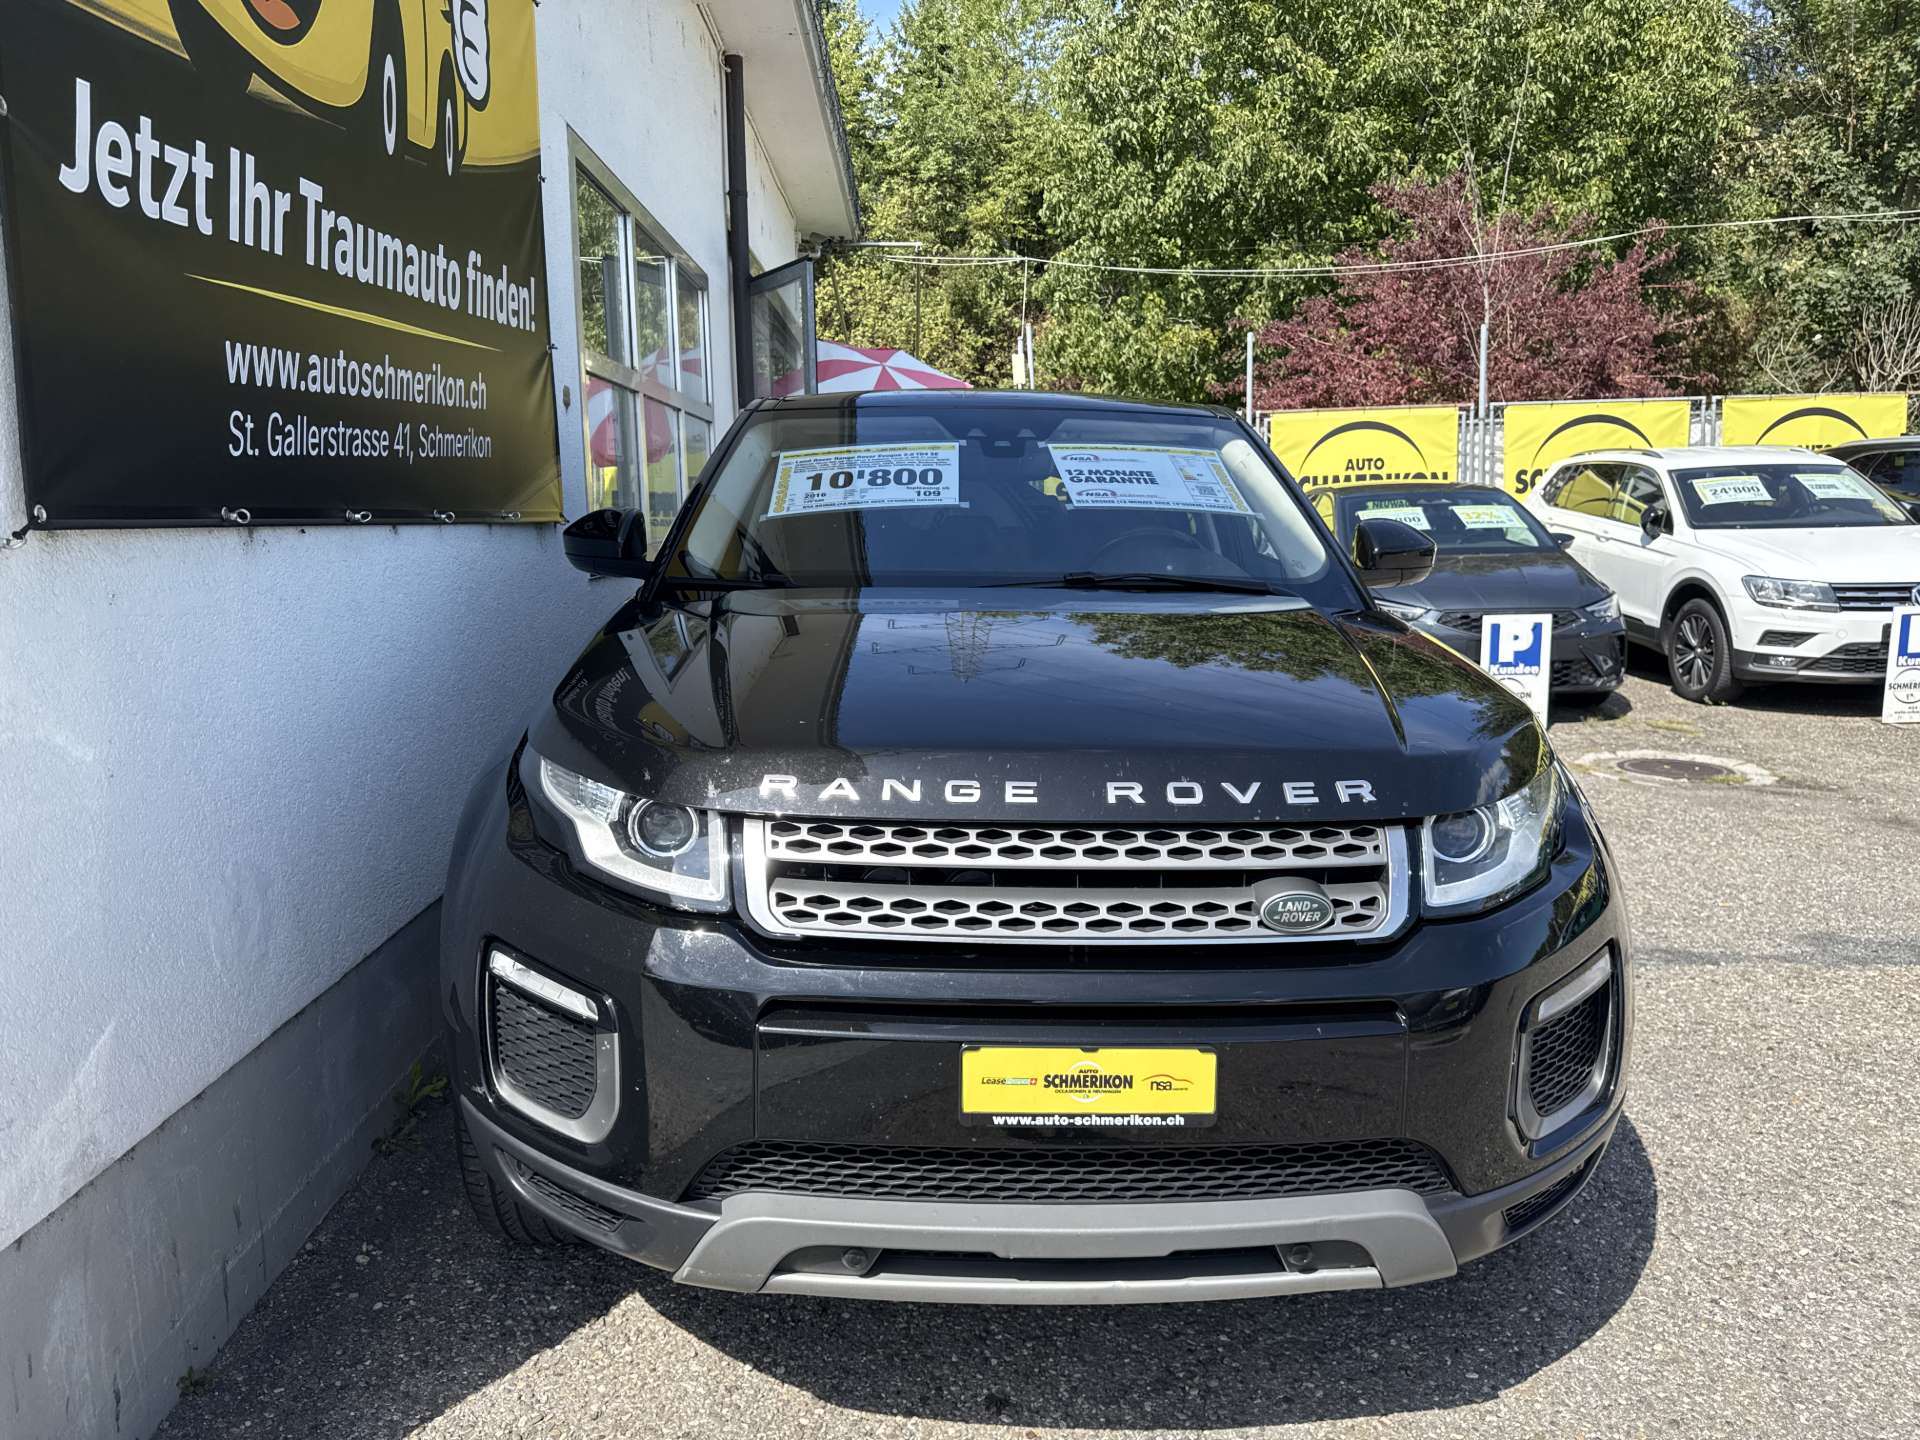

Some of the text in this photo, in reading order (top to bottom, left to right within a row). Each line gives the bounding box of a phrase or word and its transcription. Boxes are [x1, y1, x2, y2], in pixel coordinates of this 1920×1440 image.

[58, 77, 536, 333] Jetzt Ihr Traumauto finden!
[225, 340, 488, 411] www.autoschmerikon.ch
[228, 411, 492, 465] St. Gallerstrasse 41, Schmerikon
[1344, 457, 1385, 472] AUTO
[806, 468, 943, 491] 10'800
[1069, 476, 1159, 485] GARANTIE
[1086, 469, 1154, 478] MONATE
[1709, 485, 1761, 496] 24'800
[1489, 662, 1540, 676] Kunden
[759, 773, 1379, 806] RANGE ROVER
[1277, 901, 1311, 912] LAND
[1280, 911, 1321, 923] ROVER
[1043, 1074, 1134, 1089] SCHMERIKON
[1150, 1081, 1172, 1091] nsa
[992, 1114, 1185, 1126] www.auto-schmerikon.ch
